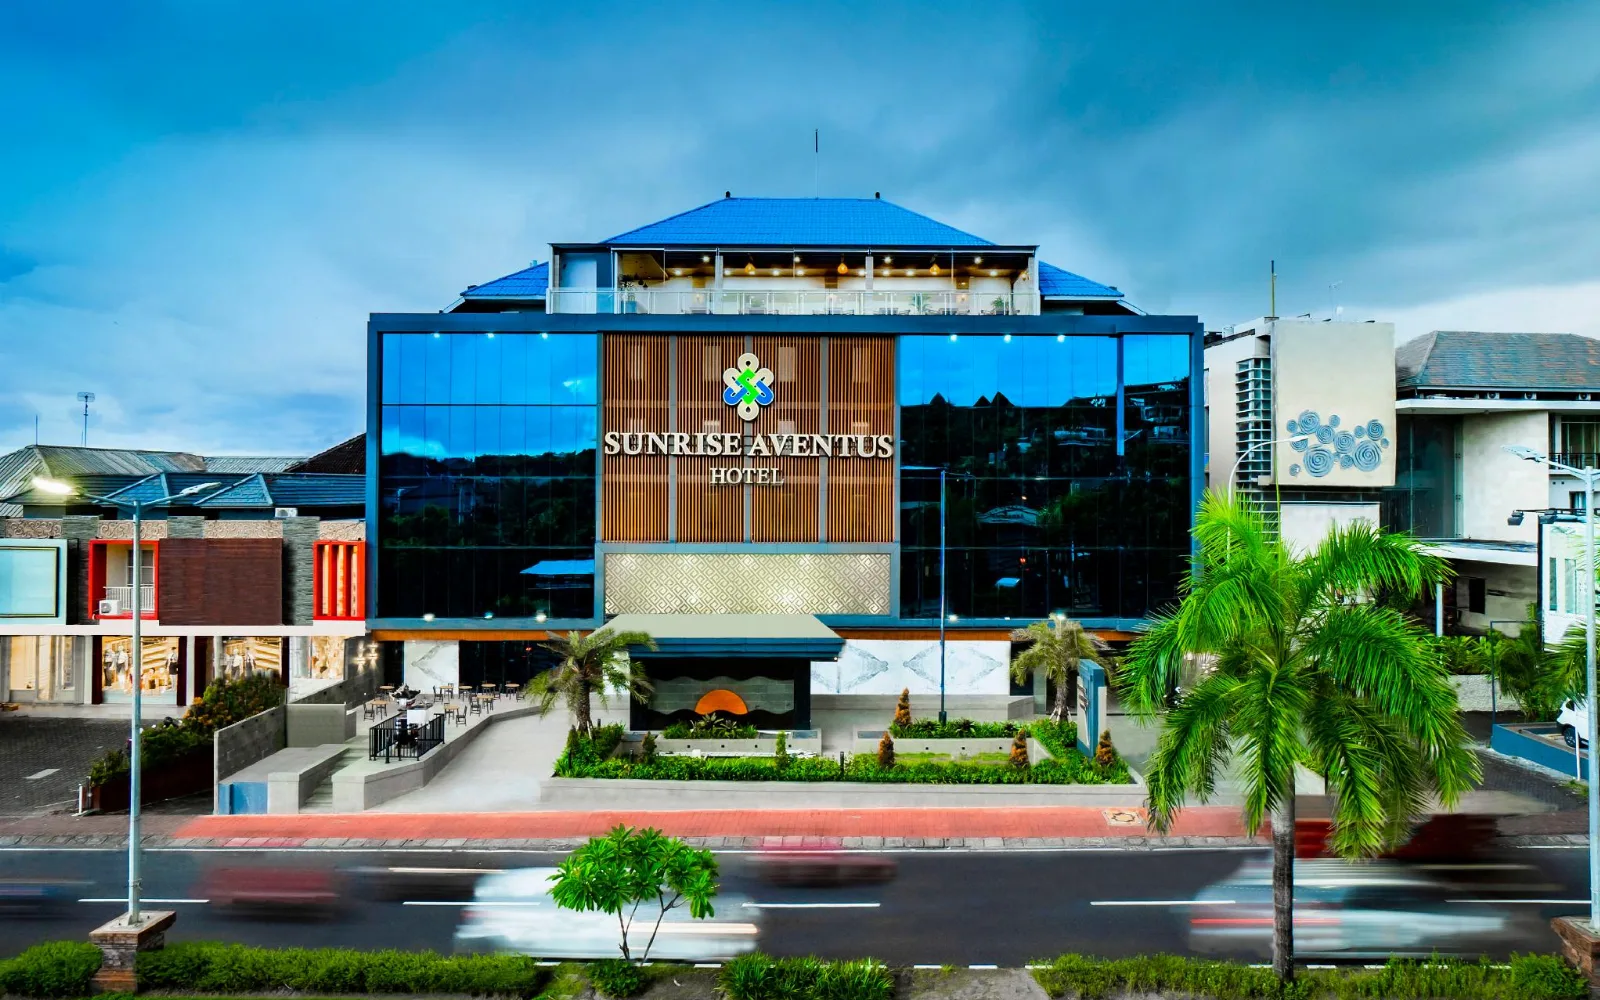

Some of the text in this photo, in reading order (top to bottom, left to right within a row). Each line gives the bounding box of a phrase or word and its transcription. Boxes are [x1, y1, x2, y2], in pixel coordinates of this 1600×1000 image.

[604, 431, 894, 457] SUNRISE AVENTUS
[710, 467, 784, 484] HOTEL
